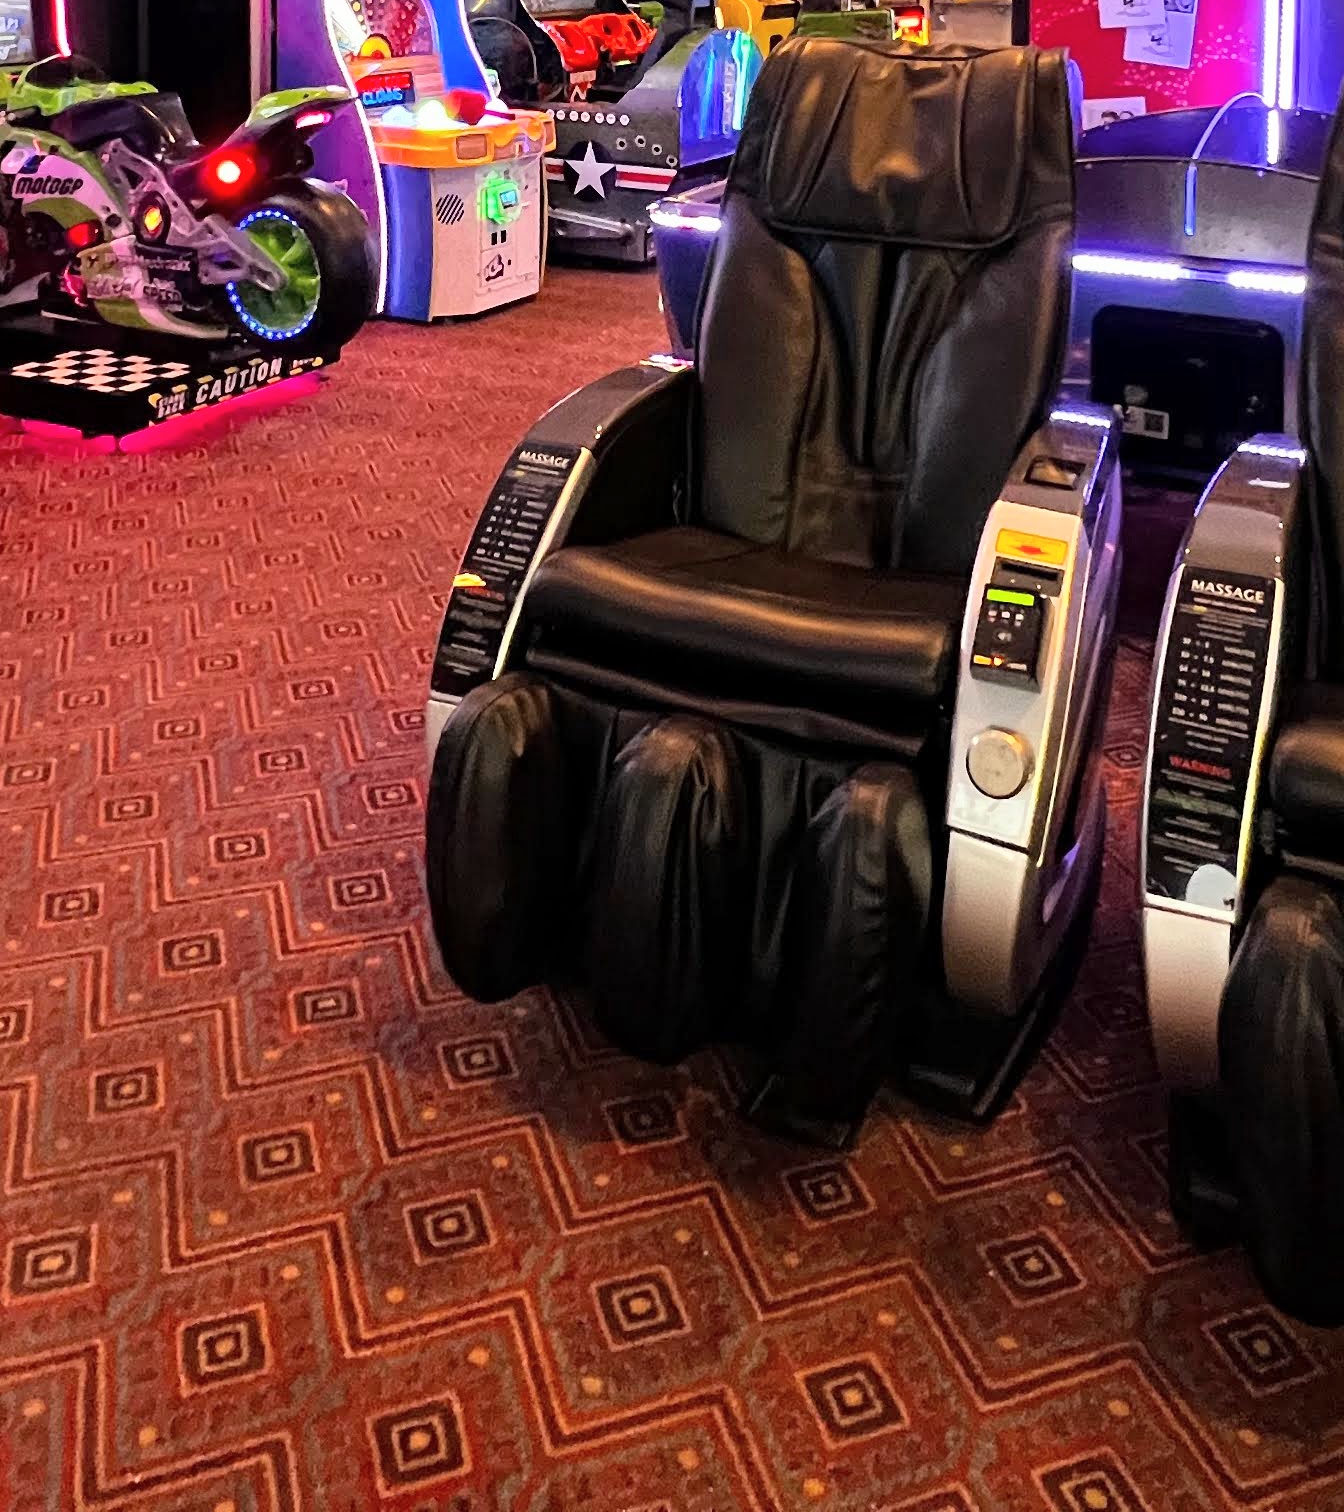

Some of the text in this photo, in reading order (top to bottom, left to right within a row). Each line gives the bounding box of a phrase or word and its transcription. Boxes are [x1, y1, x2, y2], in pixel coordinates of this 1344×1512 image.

[196, 358, 282, 404] CAUTION
[518, 450, 571, 469] MASSAGE
[1190, 579, 1265, 604] MASSAGE
[1169, 755, 1232, 780] WARNING
